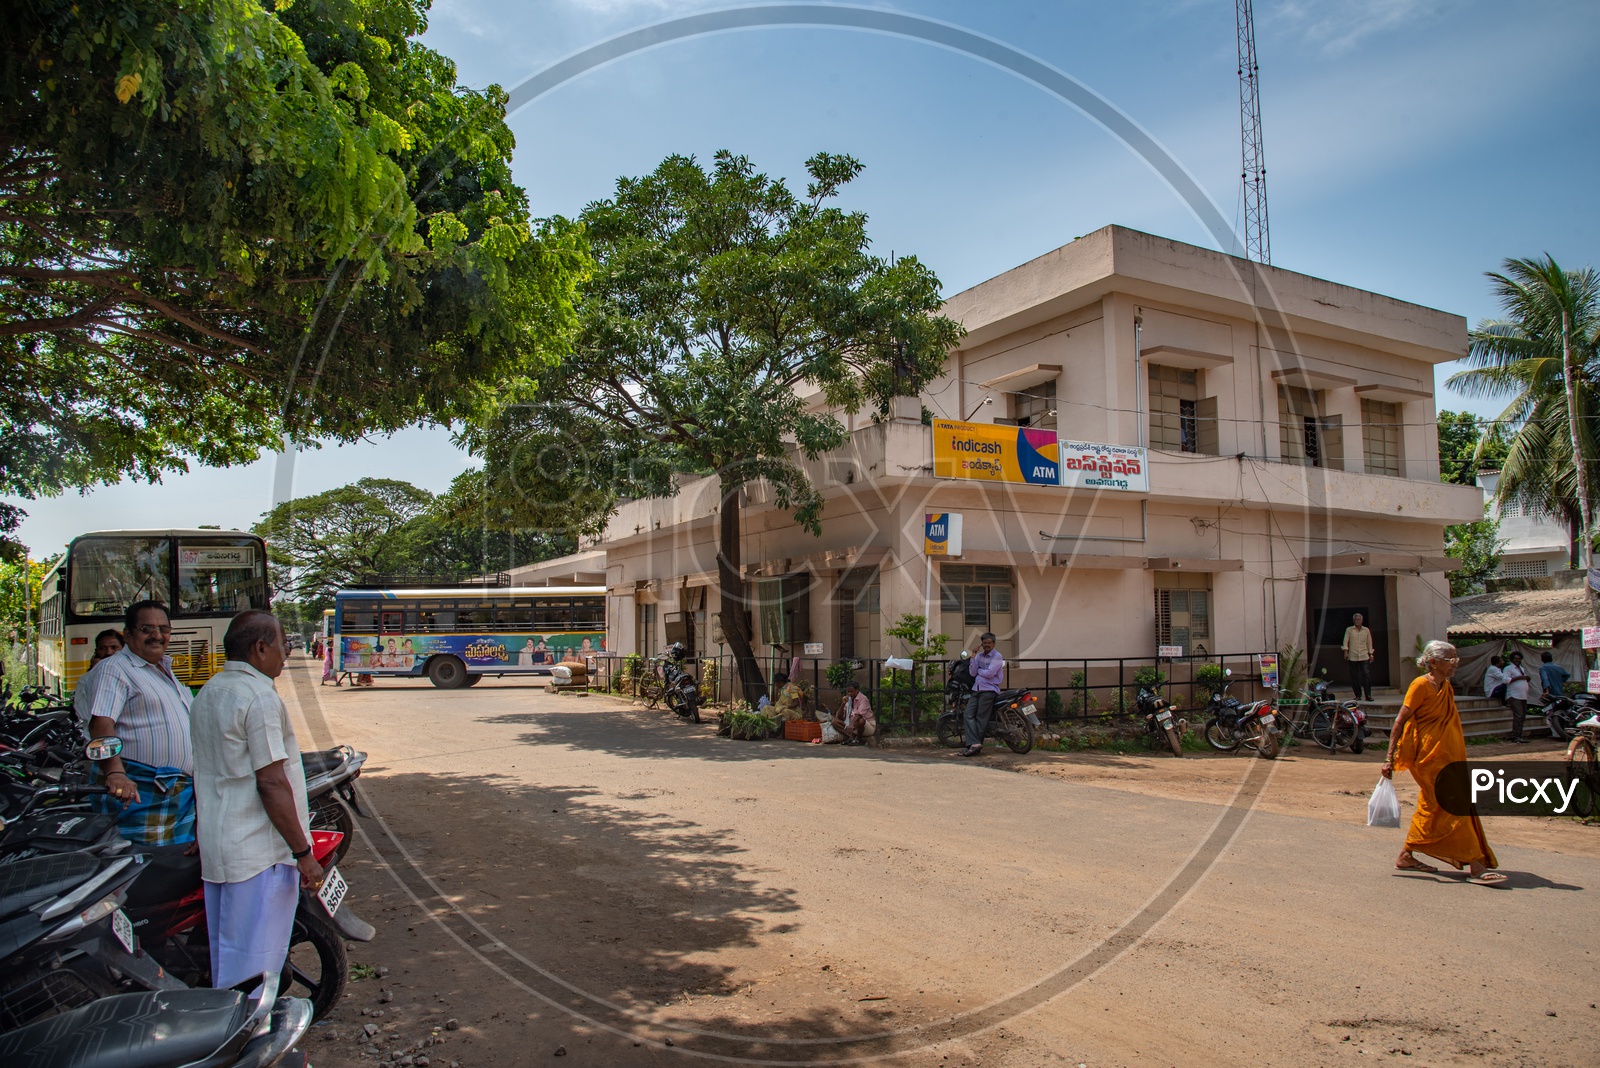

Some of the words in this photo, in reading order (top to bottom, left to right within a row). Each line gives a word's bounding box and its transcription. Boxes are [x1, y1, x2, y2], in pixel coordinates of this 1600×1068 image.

[952, 436, 1002, 454] indicash
[1032, 466, 1055, 478] ATM
[929, 524, 945, 536] ATM
[326, 880, 346, 912] 3569
